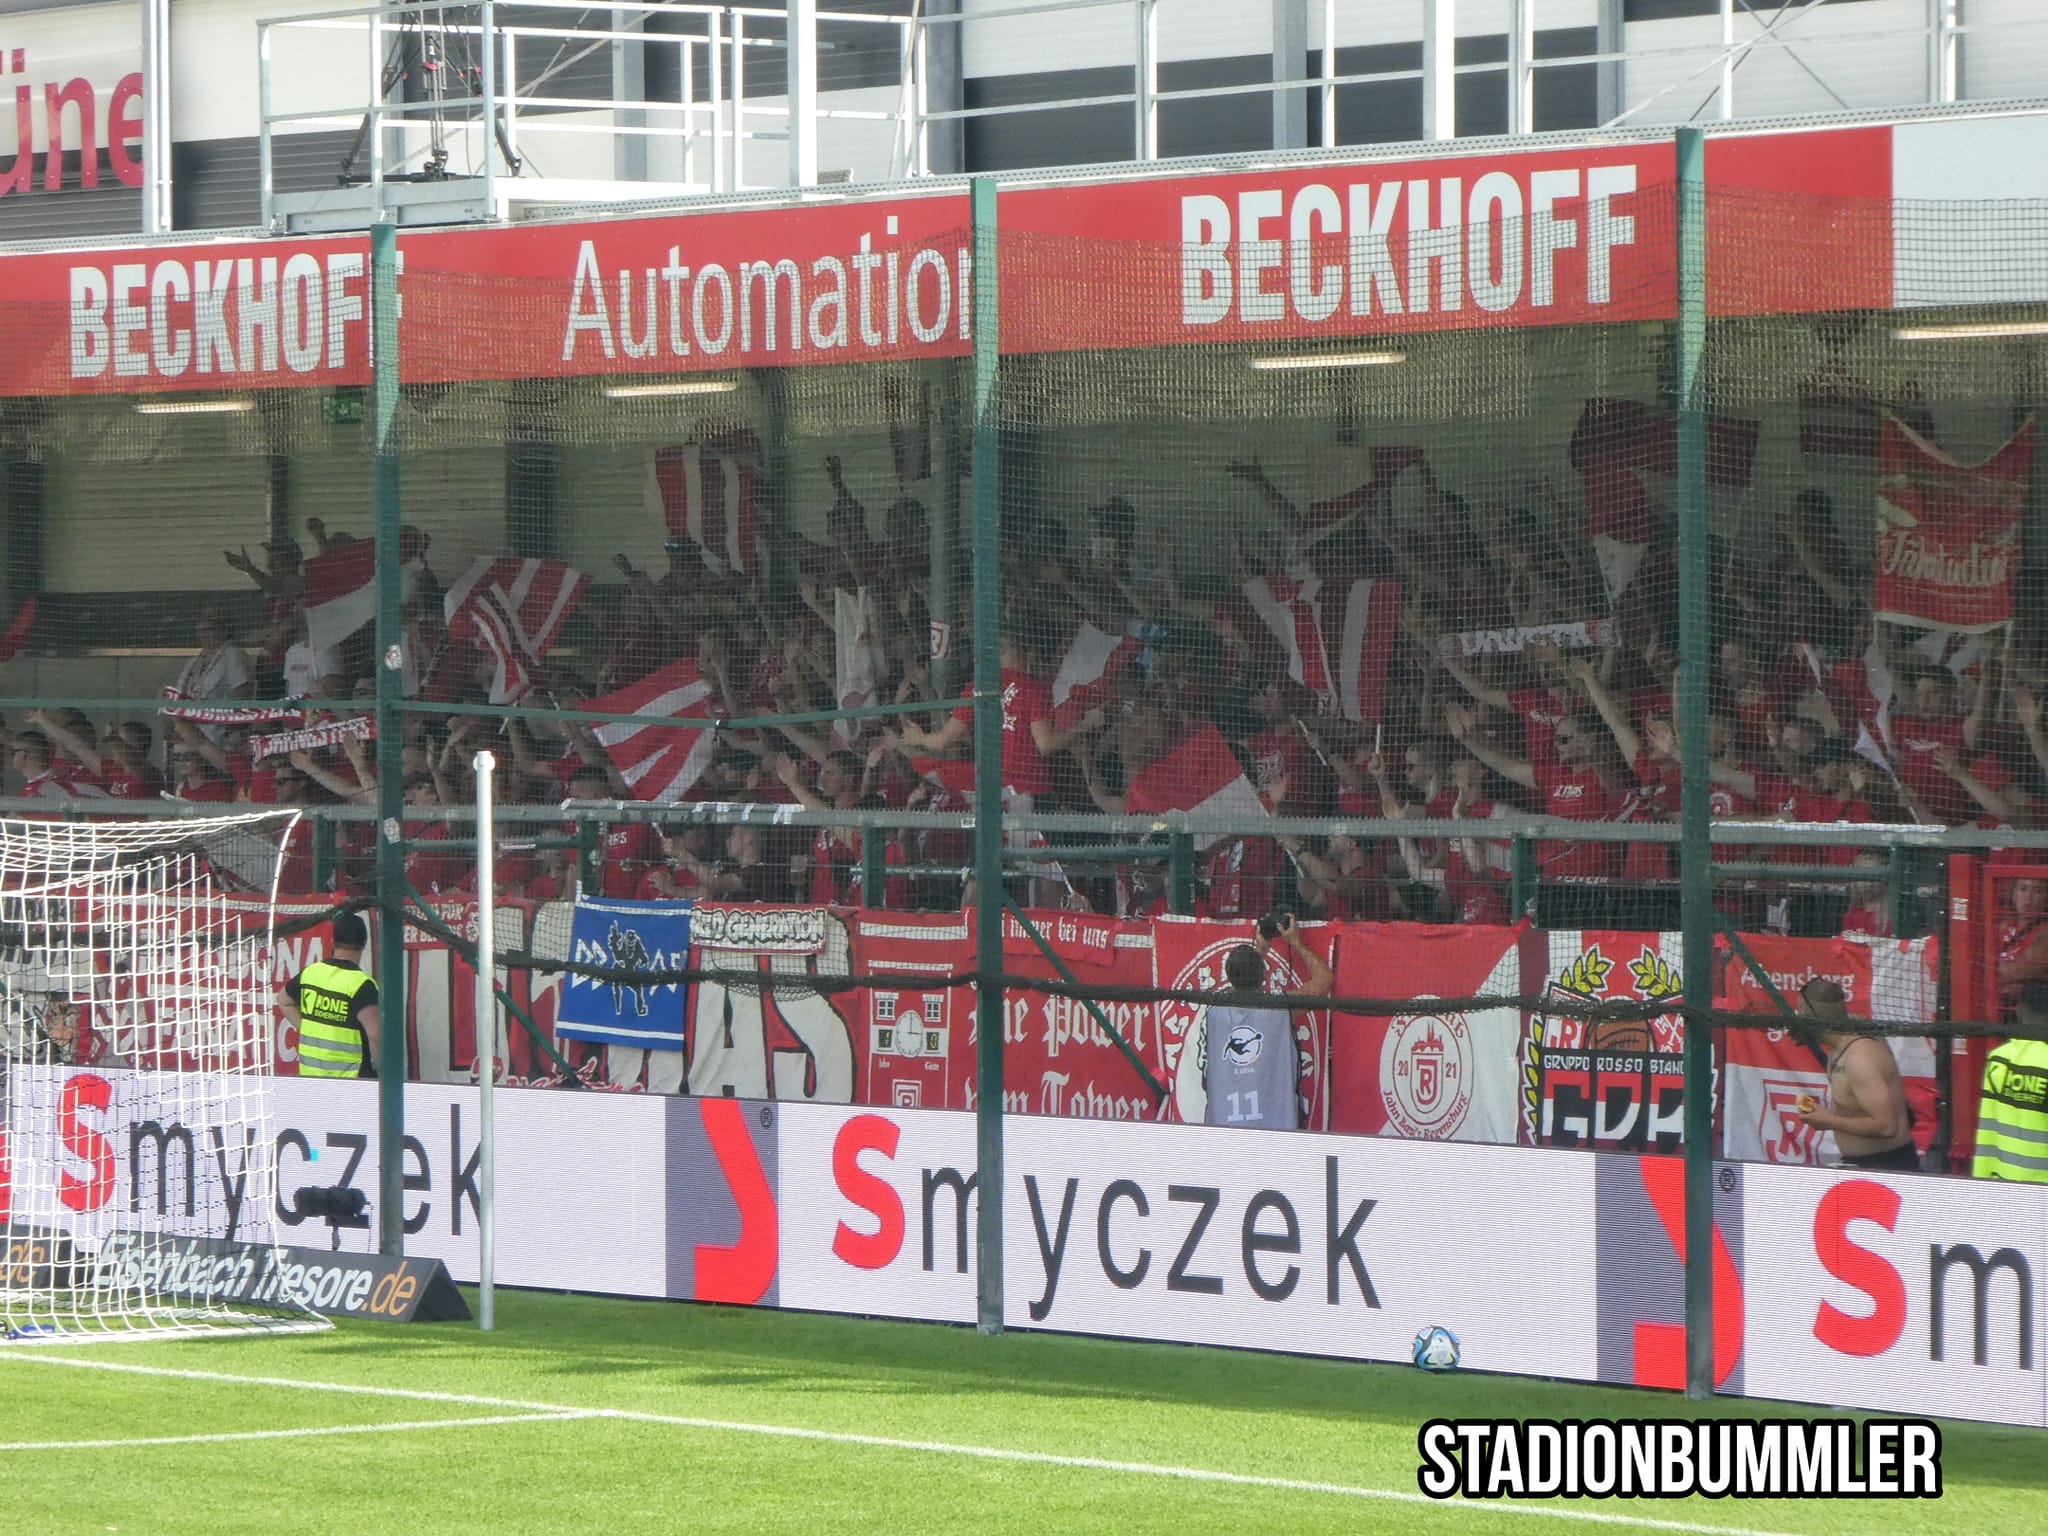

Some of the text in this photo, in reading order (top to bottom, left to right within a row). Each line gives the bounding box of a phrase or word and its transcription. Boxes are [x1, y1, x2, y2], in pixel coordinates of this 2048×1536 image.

[1181, 164, 1637, 326] BECKHOFF
[70, 252, 404, 379] BECKHOF
[1058, 917, 1077, 942] bei
[1083, 925, 1110, 949] uns
[1227, 1090, 1263, 1122] 11
[1398, 1060, 1457, 1079] 20 21
[1596, 1057, 1643, 1073] ROSSO
[57, 1073, 486, 1240] Smyczek
[832, 1114, 1382, 1322] Smyczek
[92, 1232, 418, 1317] Eisenbach Tresore.de
